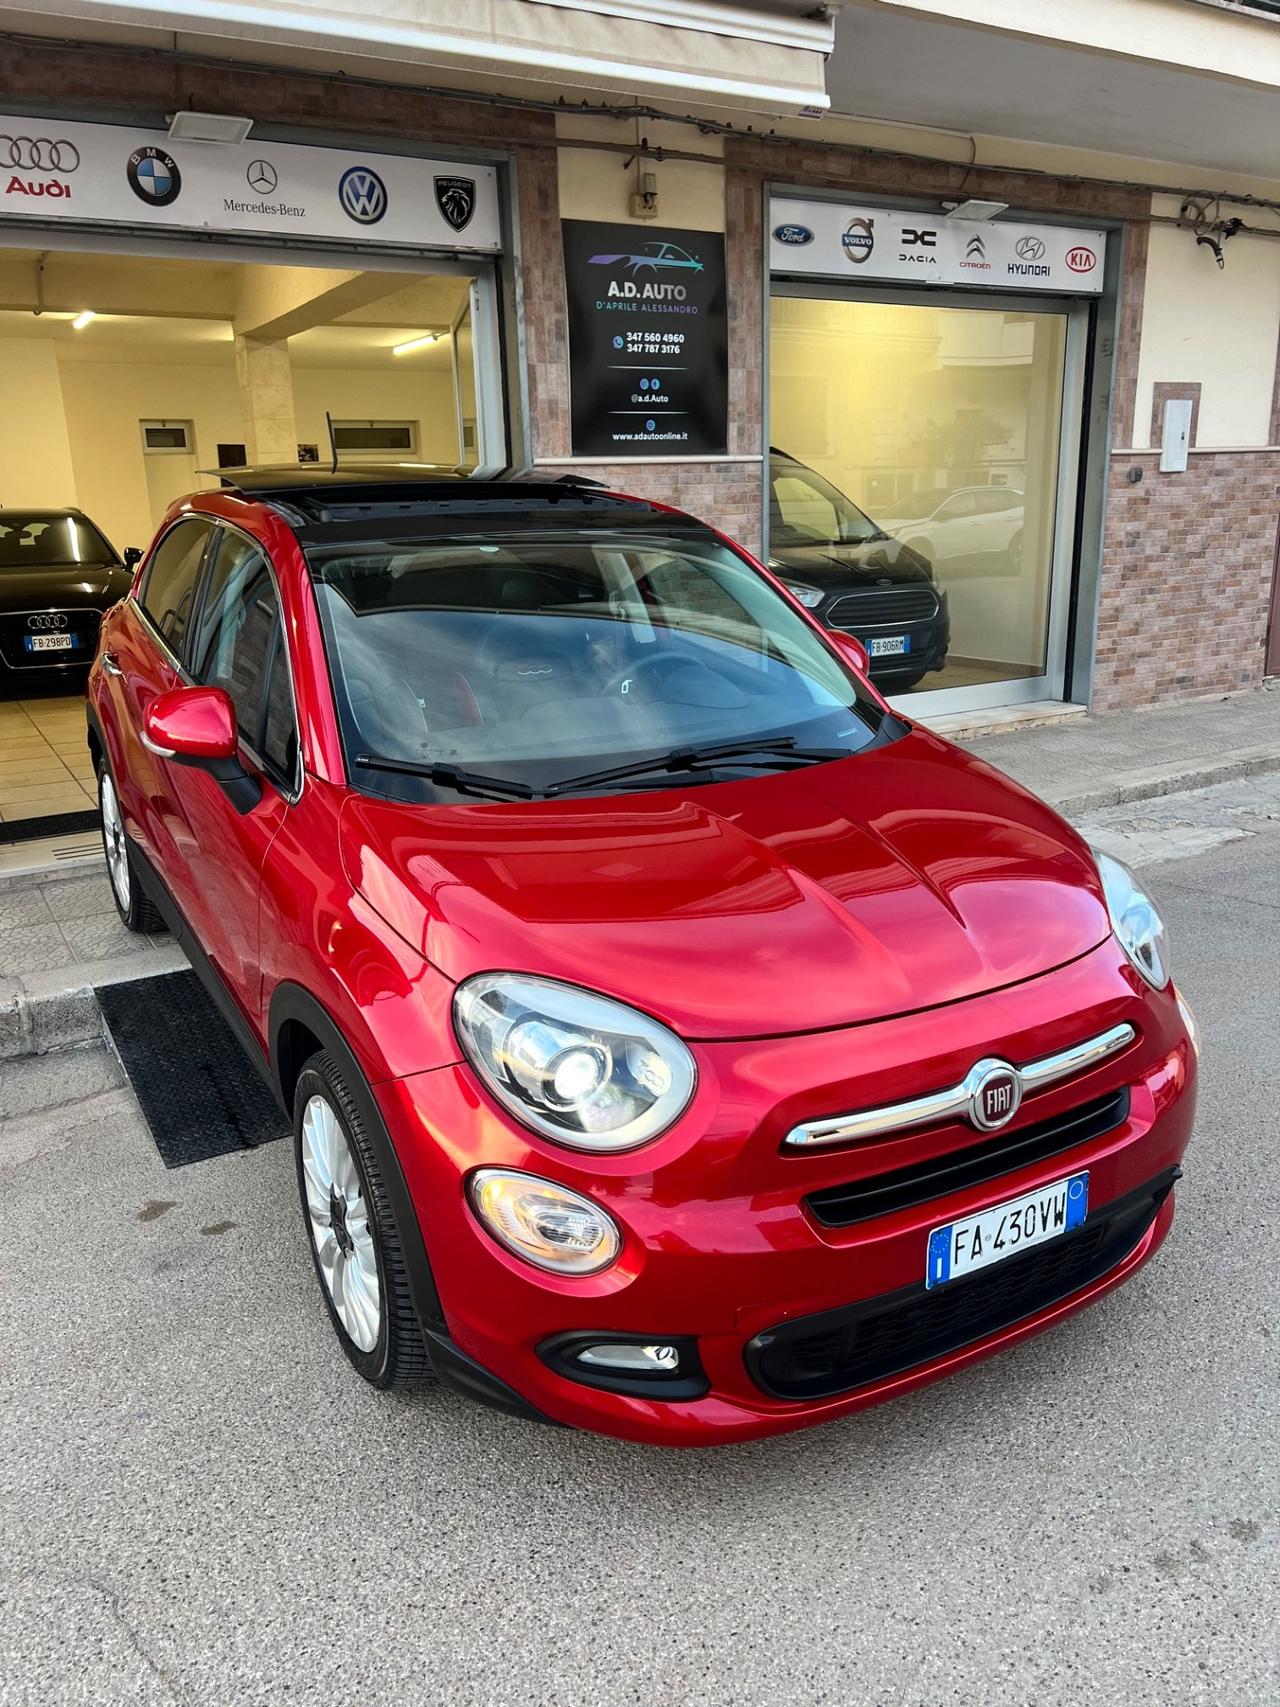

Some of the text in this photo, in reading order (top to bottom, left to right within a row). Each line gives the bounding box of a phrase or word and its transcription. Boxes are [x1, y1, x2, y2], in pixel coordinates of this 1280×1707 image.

[6, 175, 72, 198] Audi
[223, 198, 306, 218] Mercedes-Benz
[781, 226, 805, 243] Ford
[844, 236, 872, 246] VOLVO
[899, 253, 936, 264] DACIA
[1070, 252, 1091, 268] KIA
[1008, 263, 1051, 277] HYUNDAI
[596, 300, 698, 315] D'APRILE ALESSANDRO
[626, 331, 685, 344] 347 560 4960
[627, 343, 680, 354] 347 787 3176
[612, 432, 689, 441] www.adautoonline.it
[986, 1084, 1012, 1115] FIAT
